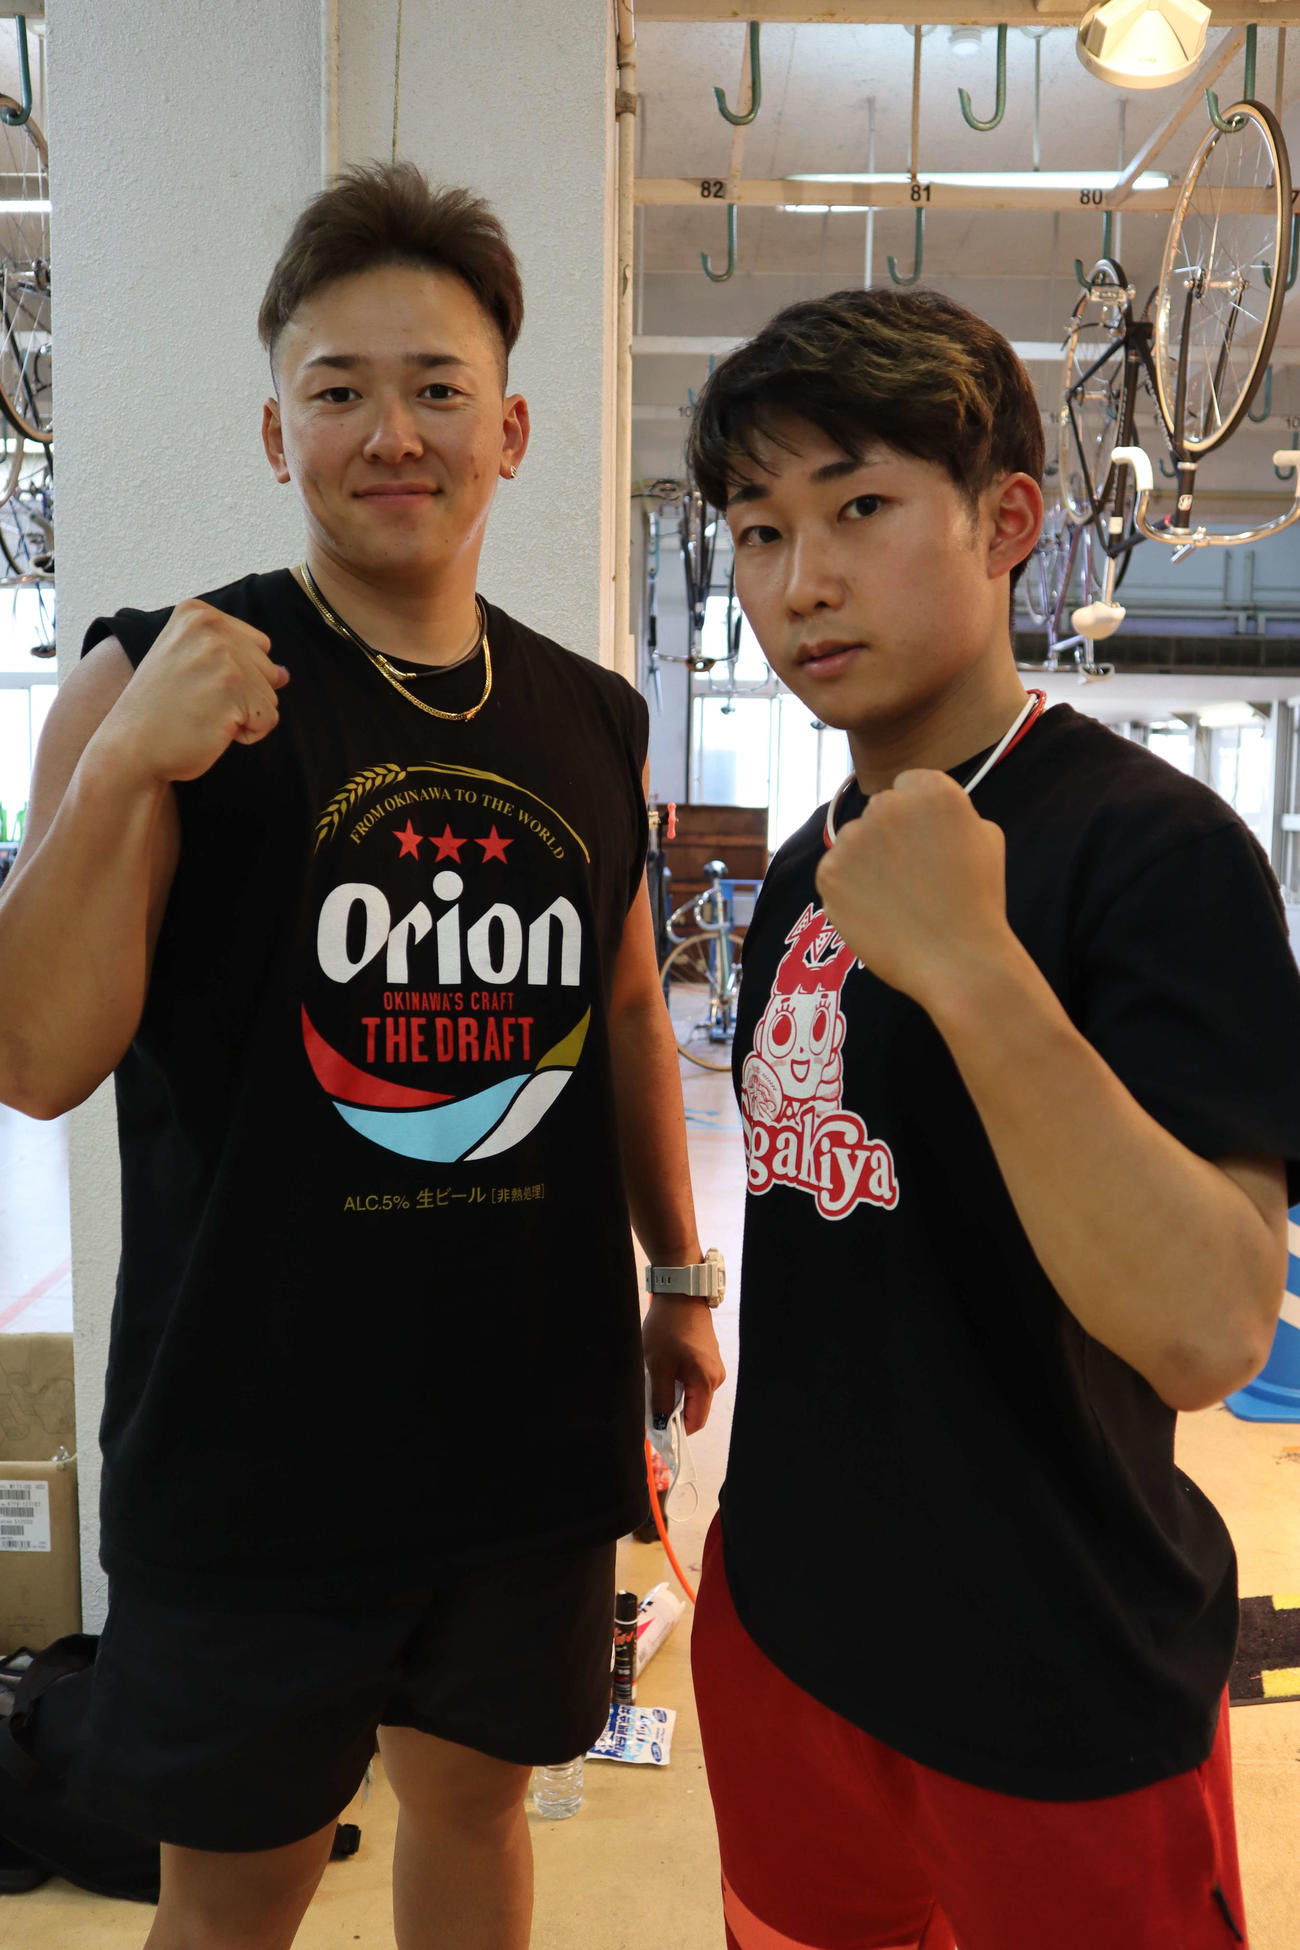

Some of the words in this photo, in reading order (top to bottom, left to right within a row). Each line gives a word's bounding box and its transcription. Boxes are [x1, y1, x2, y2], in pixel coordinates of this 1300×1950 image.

[700, 181, 725, 198] 82
[910, 184, 932, 202] 81
[1080, 188, 1103, 206] 80
[350, 804, 386, 845] FROM
[384, 786, 451, 812] OKINAWA
[454, 788, 477, 804] TO
[481, 794, 513, 817] THE
[518, 809, 566, 861] WORLD
[383, 991, 464, 1012] OKINAWA'S
[470, 991, 515, 1011] CRAFT
[361, 1016, 429, 1063] THE
[434, 1016, 534, 1062] DRAFT
[743, 1109, 894, 1212] gakiya
[344, 1195, 410, 1212] ALC.5%
[416, 1187, 486, 1209] 生ビール
